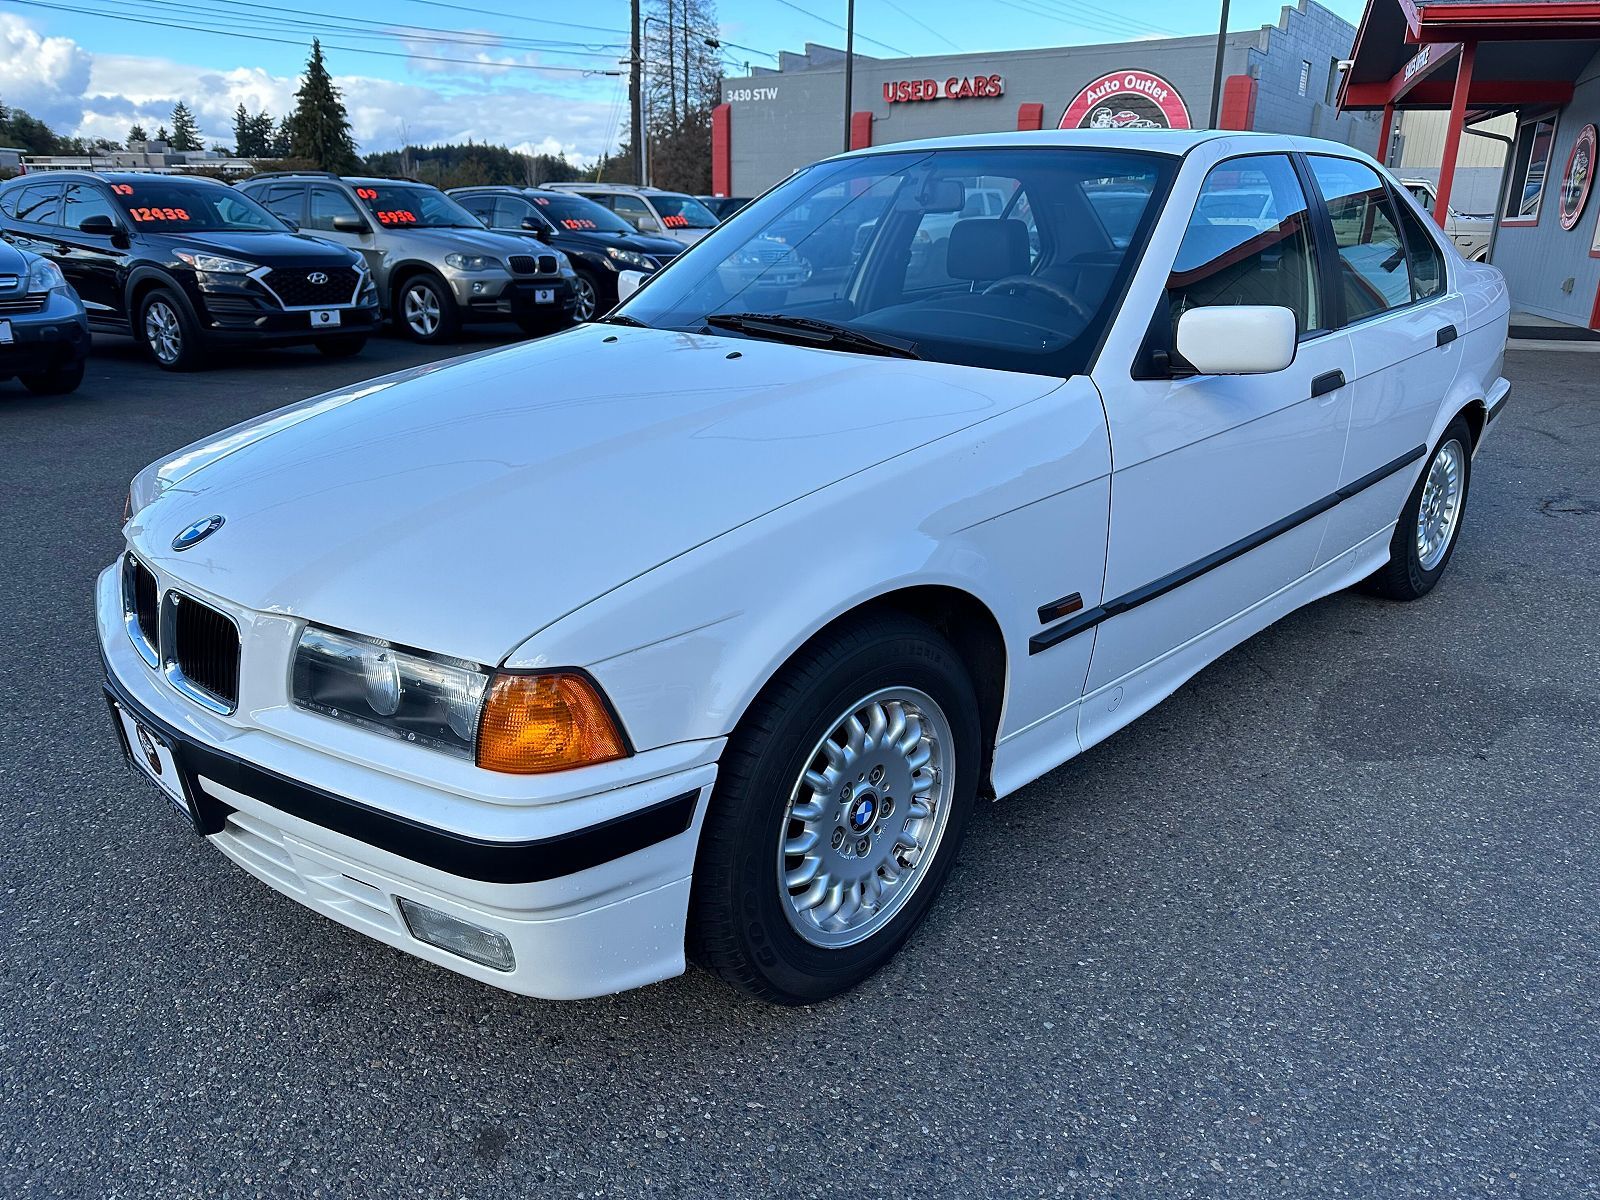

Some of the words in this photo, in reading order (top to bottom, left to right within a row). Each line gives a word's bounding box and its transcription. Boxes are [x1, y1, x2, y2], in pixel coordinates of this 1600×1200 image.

[727, 89, 751, 101] 3430
[883, 79, 938, 103] USED
[945, 74, 1002, 99] CARS
[1086, 80, 1120, 104] Auto
[1124, 74, 1167, 102] Outlet
[111, 184, 133, 195] 19
[356, 188, 378, 199] 09
[377, 210, 417, 224] 5938
